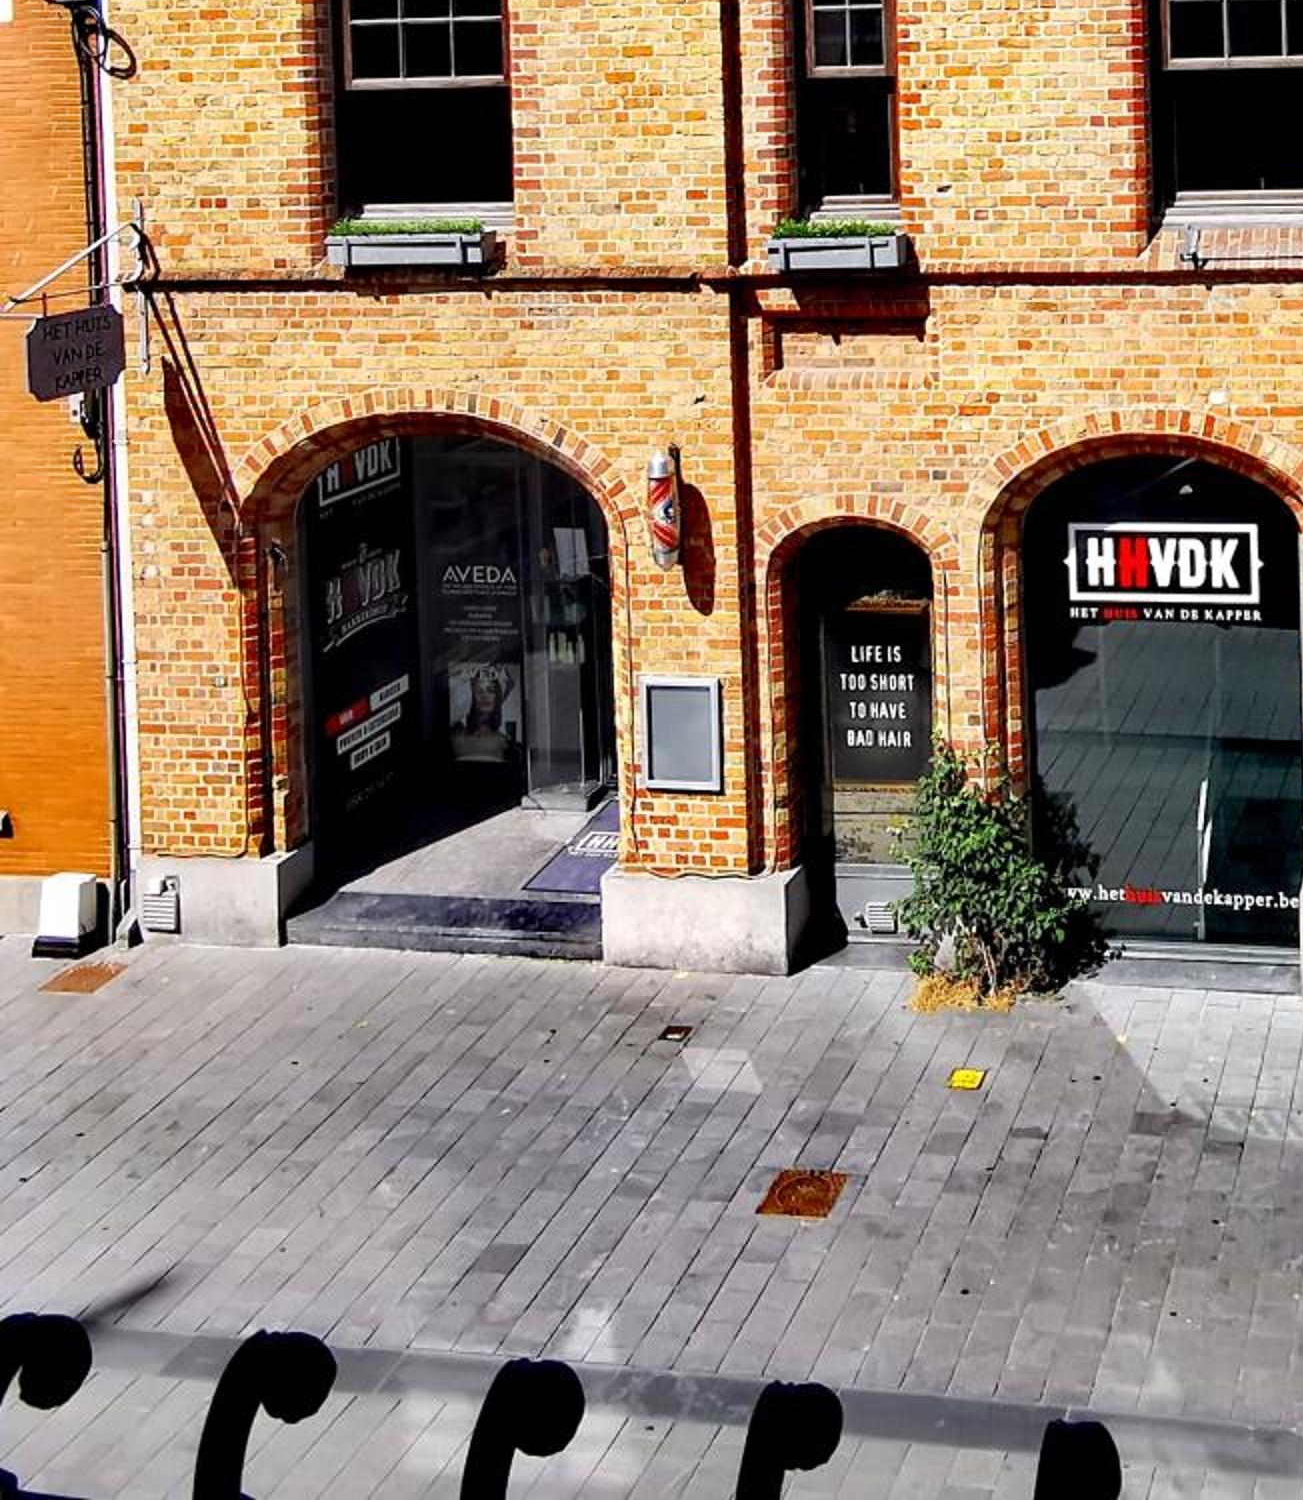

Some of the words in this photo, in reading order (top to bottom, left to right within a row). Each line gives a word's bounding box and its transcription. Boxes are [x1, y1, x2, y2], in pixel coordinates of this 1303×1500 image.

[43, 322, 72, 340] HET
[75, 315, 111, 337] HUIS
[53, 346, 83, 364] VAN
[86, 340, 105, 359] DE
[1086, 537, 1241, 589] HHVDK
[443, 565, 517, 583] AVEDA
[1069, 607, 1099, 619] HET
[1143, 607, 1175, 620] VAN
[1180, 608, 1199, 621] DE
[1204, 609, 1263, 622] KAPPER
[851, 645, 883, 663] LIFE
[887, 645, 902, 663] IS
[840, 673, 867, 691] TOO
[870, 673, 915, 691] SHORT
[849, 701, 867, 719] TO
[870, 701, 907, 719] HAVE
[847, 729, 874, 747] BAD
[878, 729, 912, 747] HAIR
